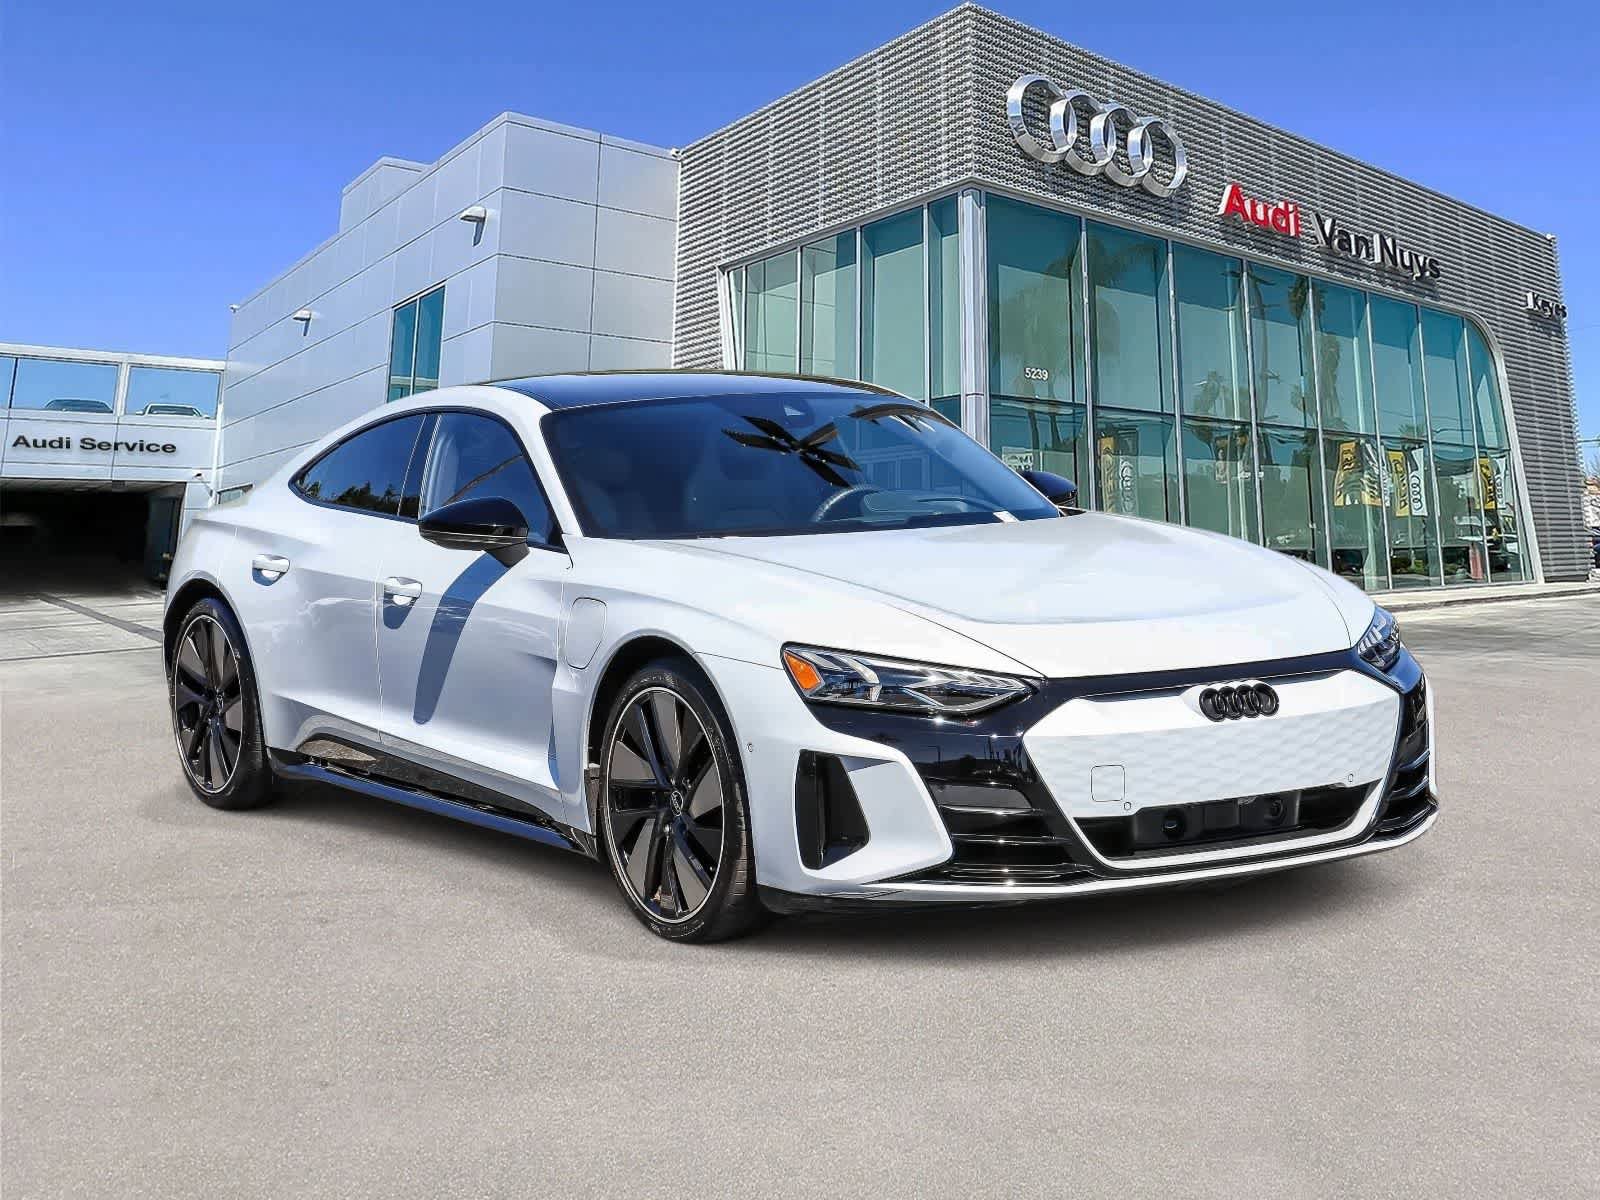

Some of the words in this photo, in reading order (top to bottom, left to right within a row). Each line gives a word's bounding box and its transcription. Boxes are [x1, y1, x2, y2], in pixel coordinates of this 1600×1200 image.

[1218, 182, 1302, 238] Audi
[1311, 211, 1371, 262] Van
[1373, 232, 1441, 281] Nuys
[1024, 367, 1049, 381] 5239
[12, 434, 71, 450] Audi
[79, 437, 177, 454] Service
